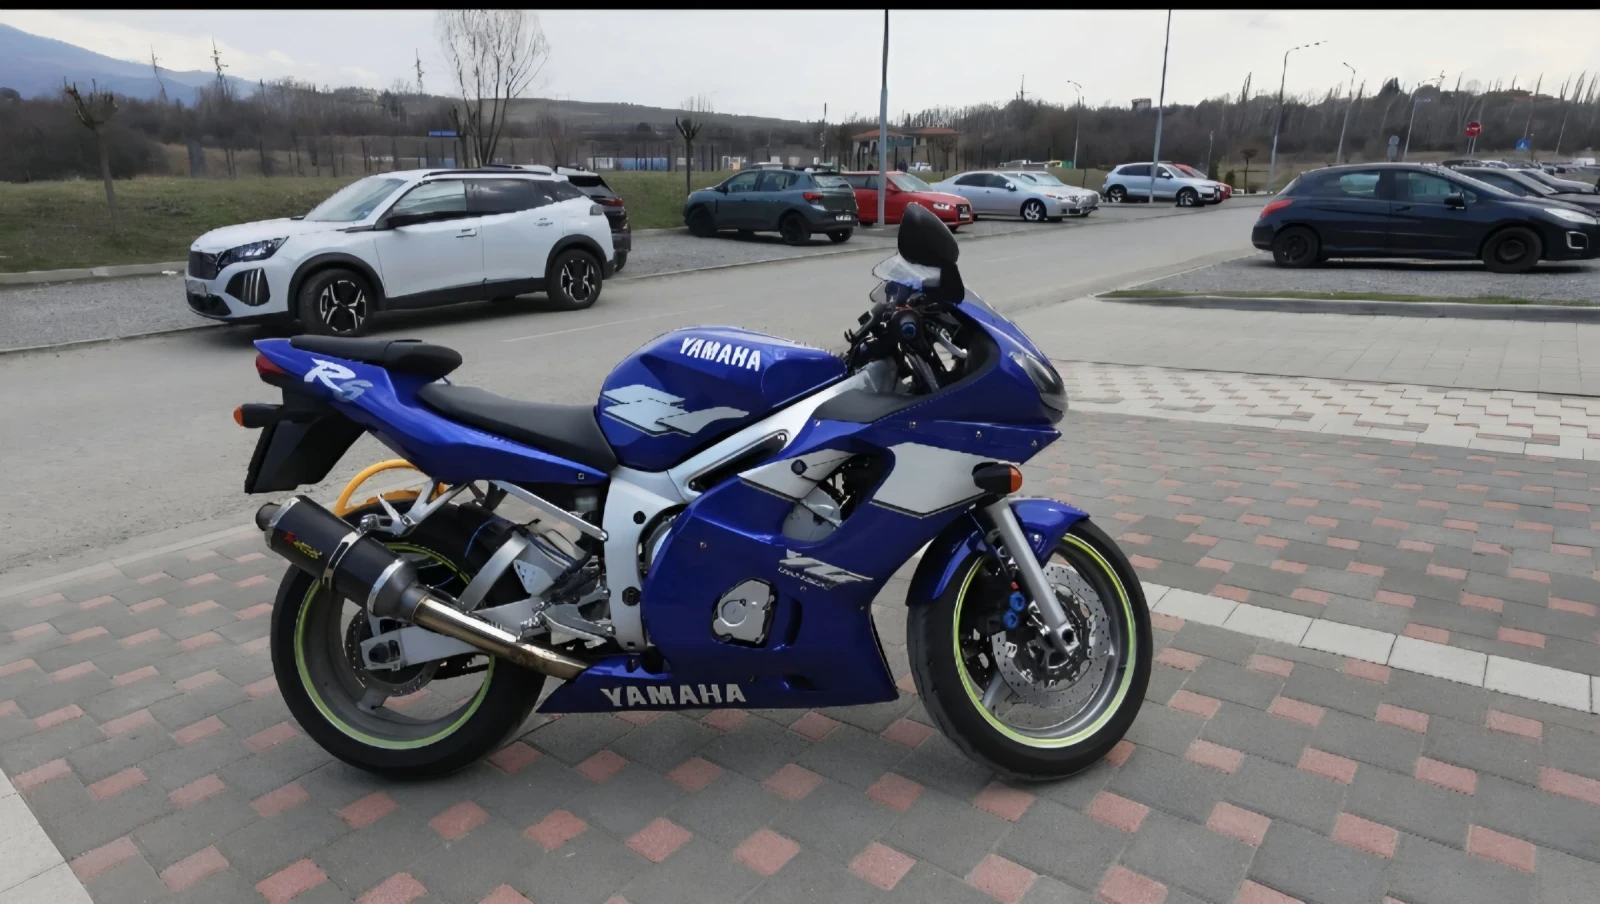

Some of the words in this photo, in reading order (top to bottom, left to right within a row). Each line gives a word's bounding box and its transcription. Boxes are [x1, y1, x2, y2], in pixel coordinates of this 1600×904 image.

[680, 337, 761, 371] YAMAHA
[304, 358, 373, 402] R6
[600, 683, 747, 707] YAMAHA
